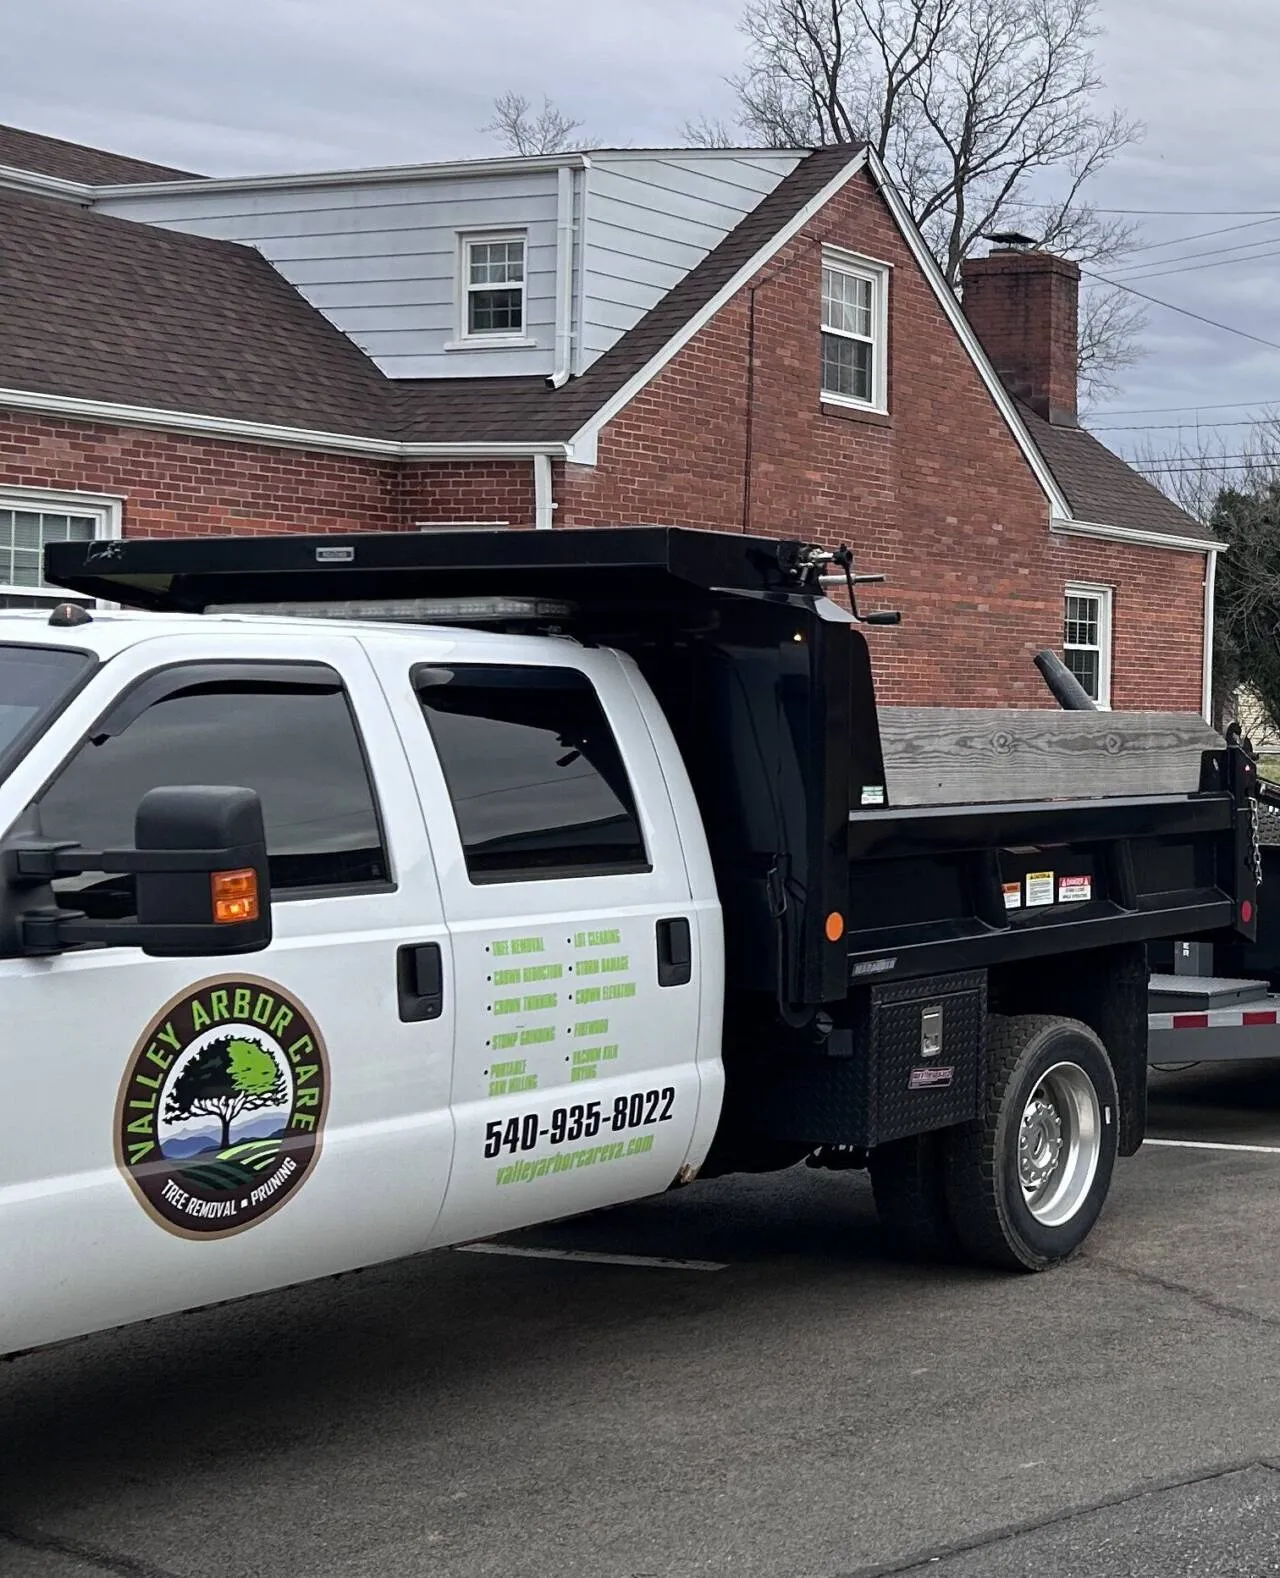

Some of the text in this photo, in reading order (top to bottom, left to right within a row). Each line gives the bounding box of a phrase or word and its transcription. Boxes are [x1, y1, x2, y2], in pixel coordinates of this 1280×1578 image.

[127, 988, 320, 1165] VALLEY ARBOR CARE
[484, 1087, 675, 1159] 540-935-8022
[161, 1157, 297, 1219] TREE REMOVAL PRUNING
[496, 1134, 654, 1185] valleyarborcareva.com
